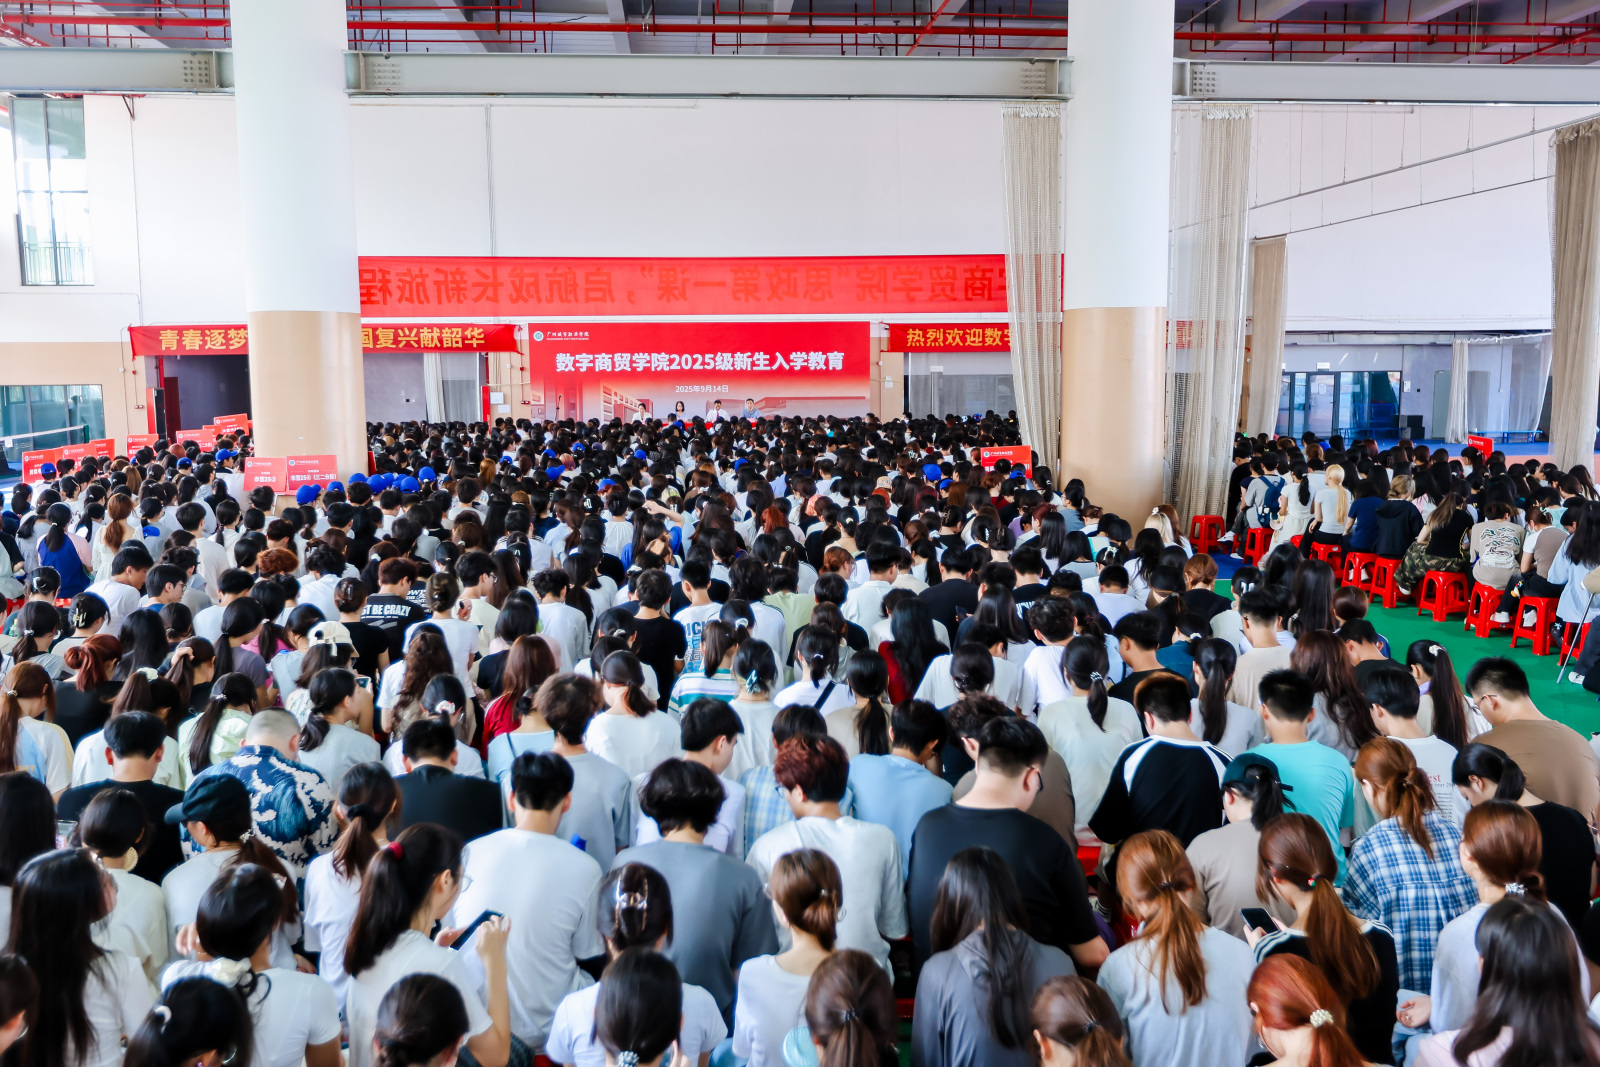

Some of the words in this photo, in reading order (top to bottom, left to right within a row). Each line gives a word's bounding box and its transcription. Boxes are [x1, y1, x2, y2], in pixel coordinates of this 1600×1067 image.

[159, 328, 248, 350] 青春逐梦
[556, 351, 845, 373] 数字商贸学院2025级新生入学教育
[675, 384, 729, 393] 2025年9月14日
[371, 604, 384, 615] BE
[383, 604, 412, 617] CRAZY
